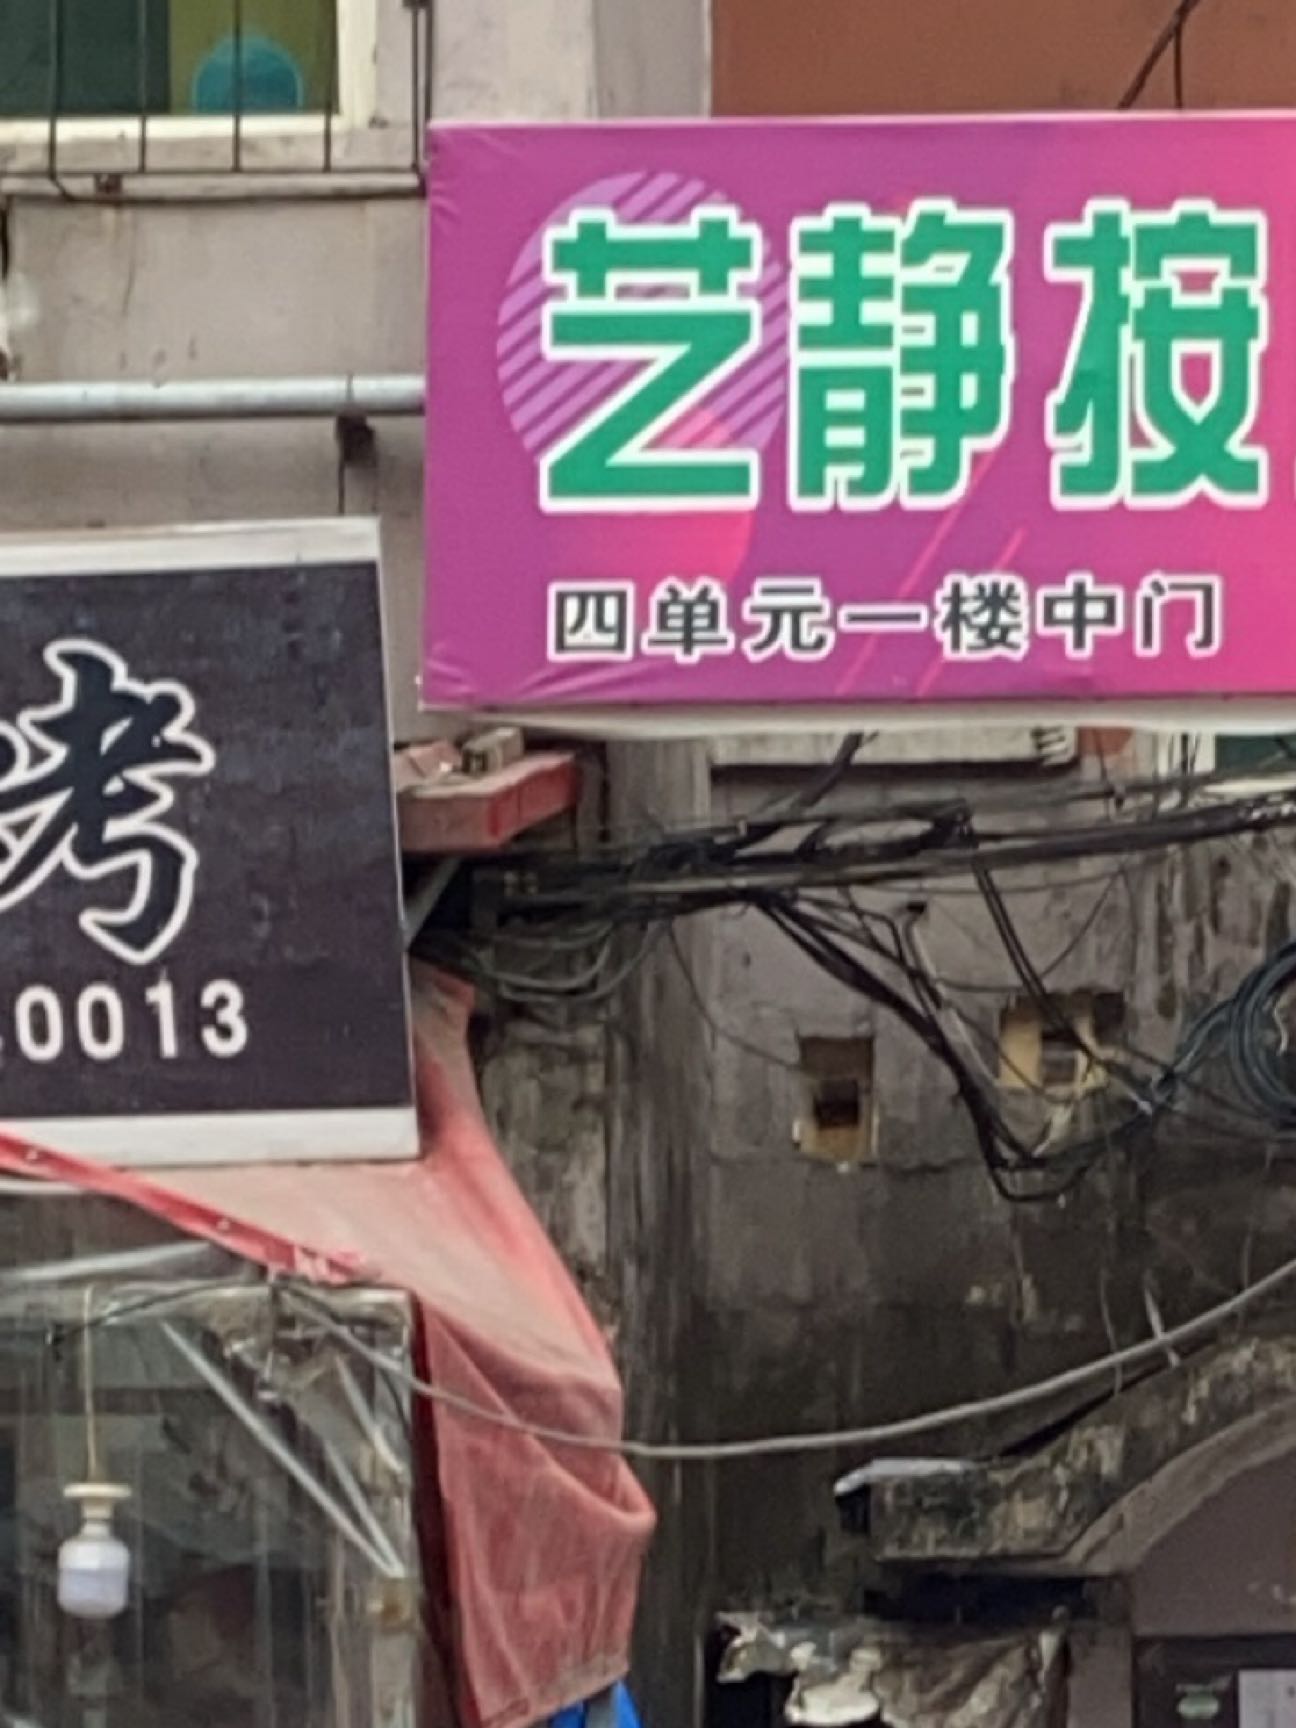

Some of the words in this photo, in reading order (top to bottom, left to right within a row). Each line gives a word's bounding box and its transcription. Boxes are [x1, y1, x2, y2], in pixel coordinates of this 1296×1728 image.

[548, 574, 1224, 664] 四单元一楼中门
[0, 979, 249, 1062] 0013
